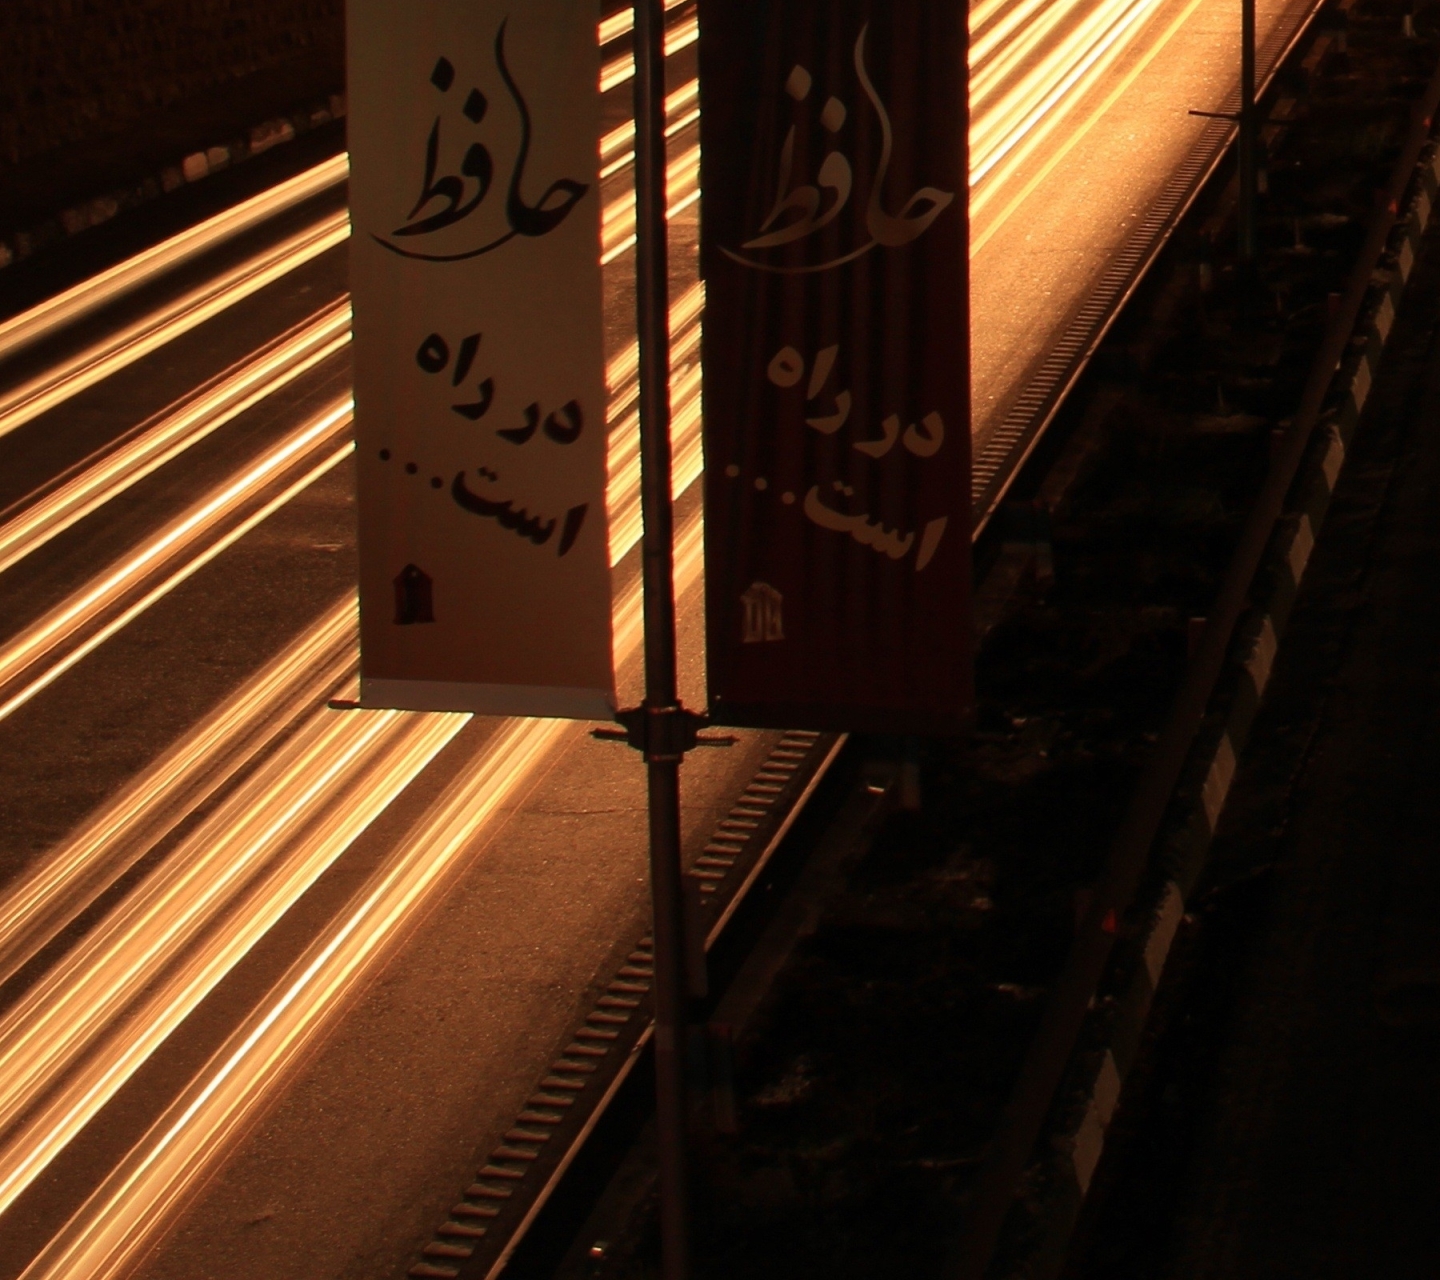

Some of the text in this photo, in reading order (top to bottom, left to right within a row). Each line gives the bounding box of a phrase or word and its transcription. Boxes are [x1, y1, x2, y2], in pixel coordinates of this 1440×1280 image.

[369, 16, 591, 262] حافظ
[716, 21, 956, 274] حافظ
[415, 332, 584, 446] در راه
[767, 343, 945, 459] در راه
